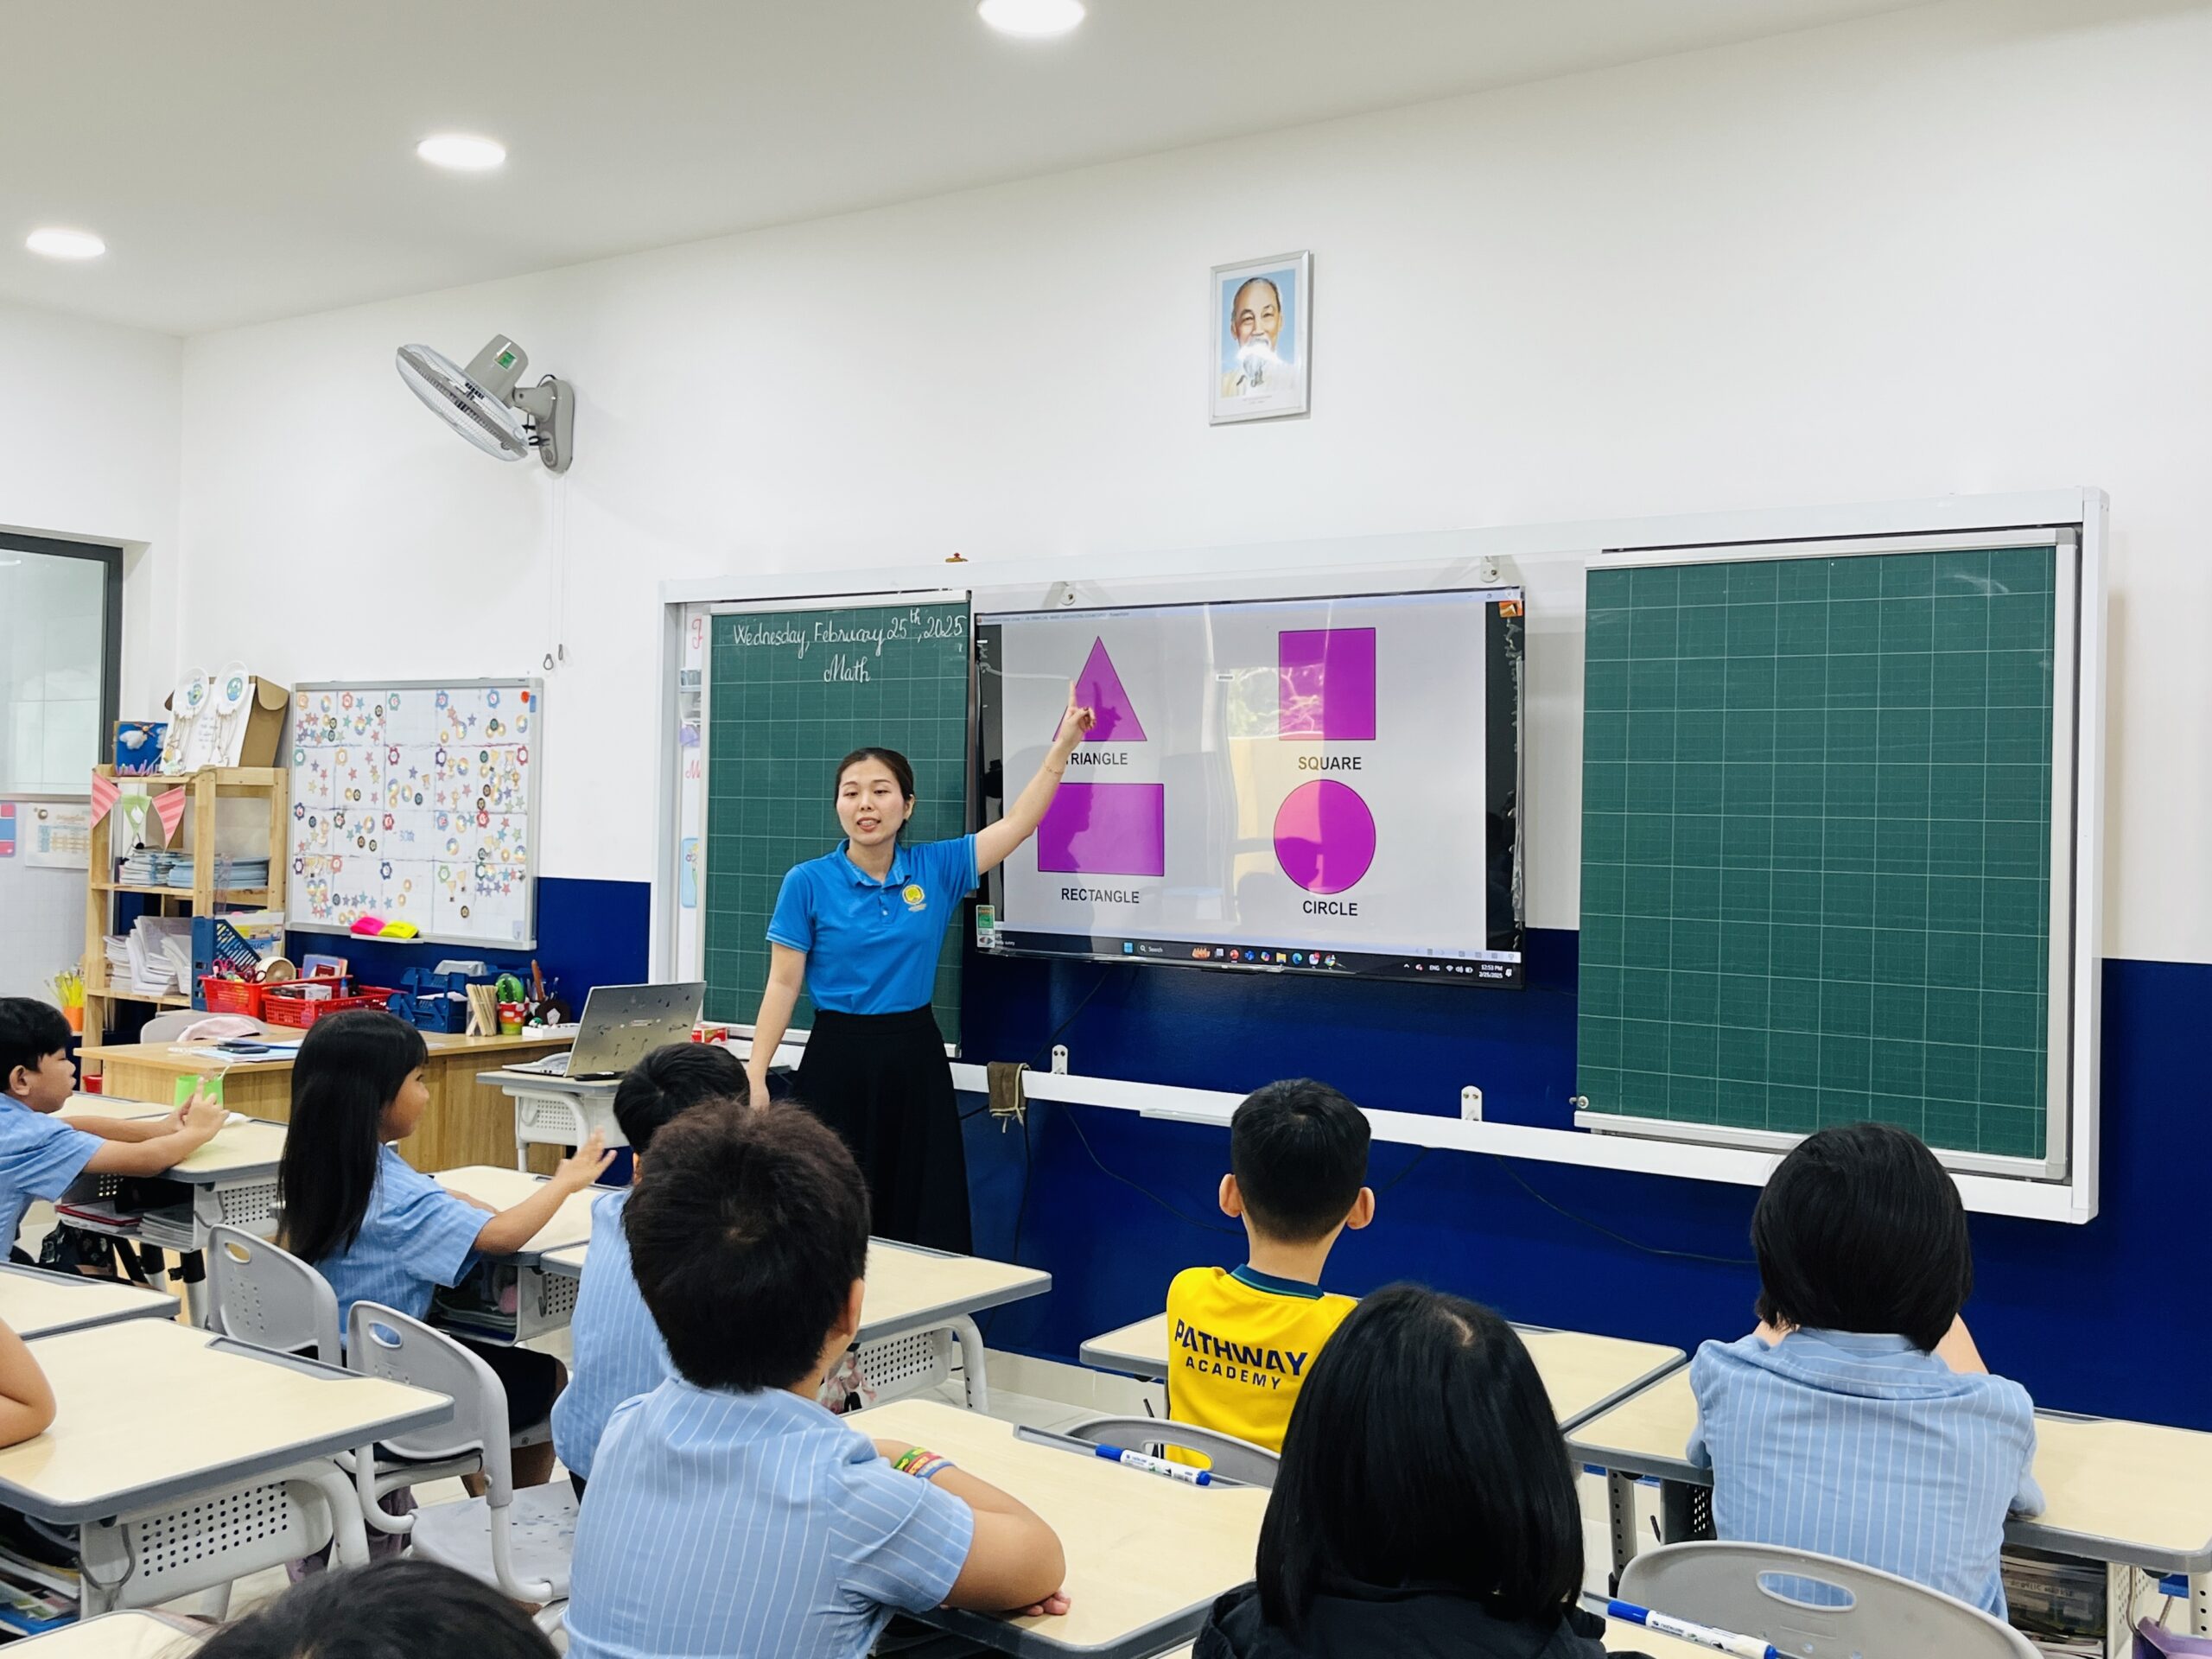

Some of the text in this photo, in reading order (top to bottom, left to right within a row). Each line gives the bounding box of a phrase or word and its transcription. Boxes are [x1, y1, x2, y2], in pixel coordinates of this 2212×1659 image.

[733, 620, 810, 659] Wednesday,
[814, 619, 885, 658] February
[823, 653, 872, 683] Math
[1297, 755, 1363, 772] SQUARE
[1060, 887, 1141, 905] RECTANGLE
[1301, 899, 1359, 918] CIRCLE
[1174, 1319, 1308, 1376] PATHWAY
[1185, 1356, 1281, 1389] ACADEMY
